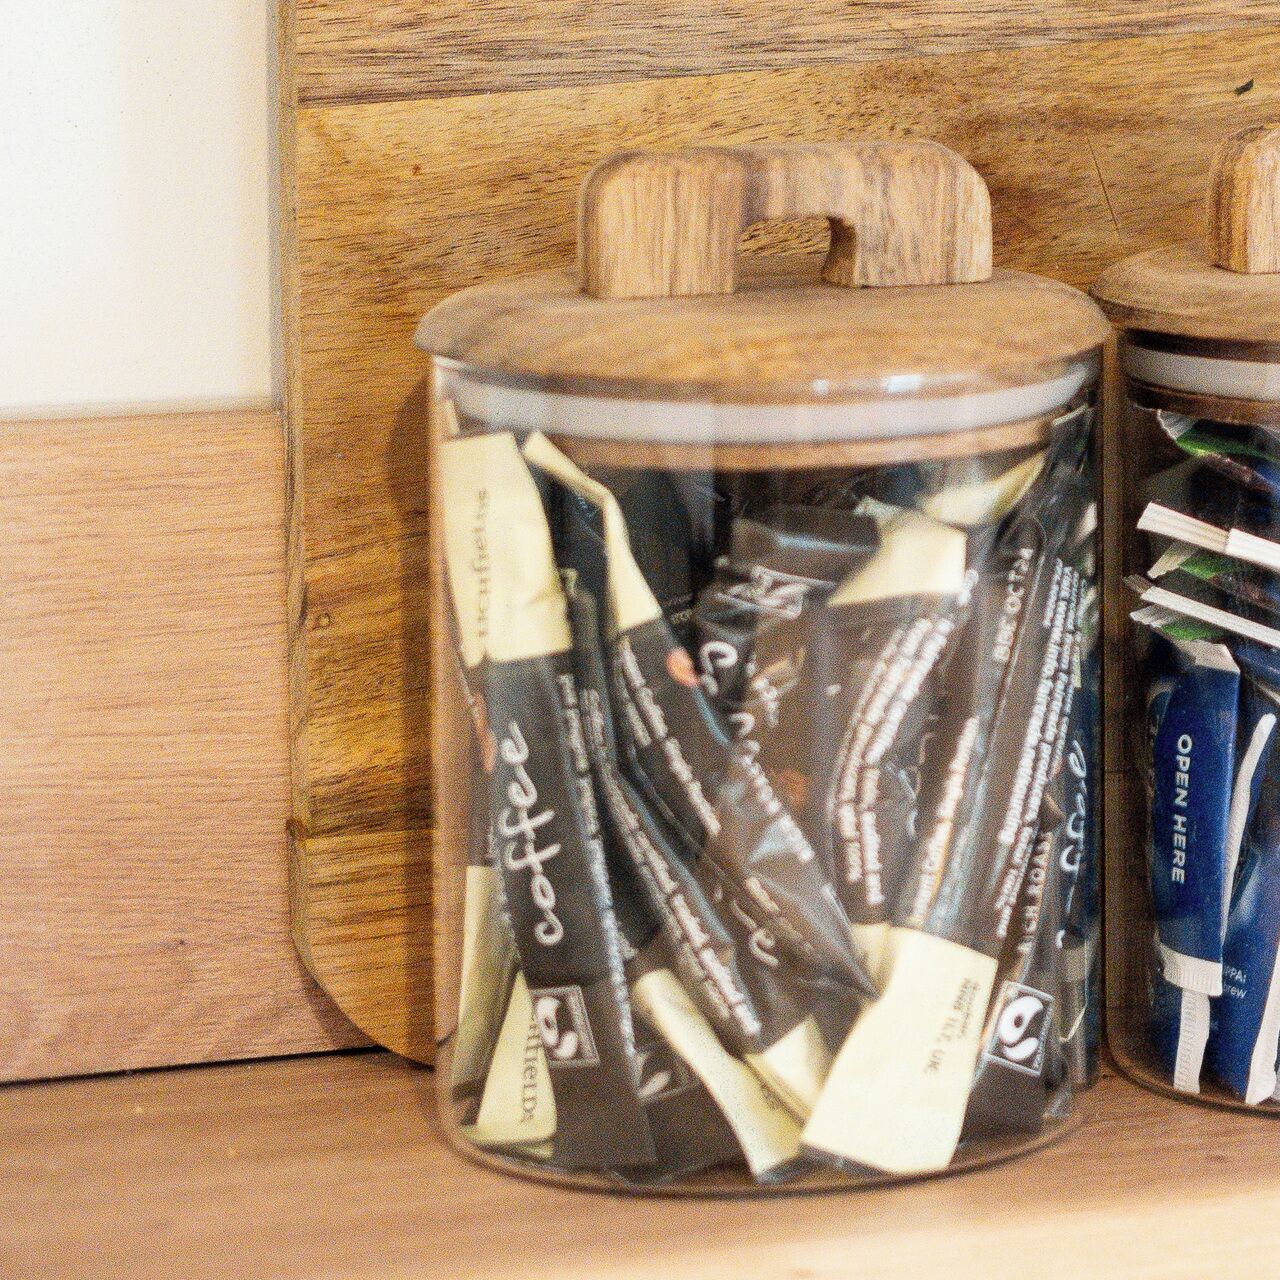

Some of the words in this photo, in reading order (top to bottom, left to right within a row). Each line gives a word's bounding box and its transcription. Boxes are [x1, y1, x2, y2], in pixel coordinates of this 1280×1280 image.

[1173, 733, 1193, 807] OPEN
[500, 720, 565, 947] coffee
[1171, 814, 1188, 885] HERE
